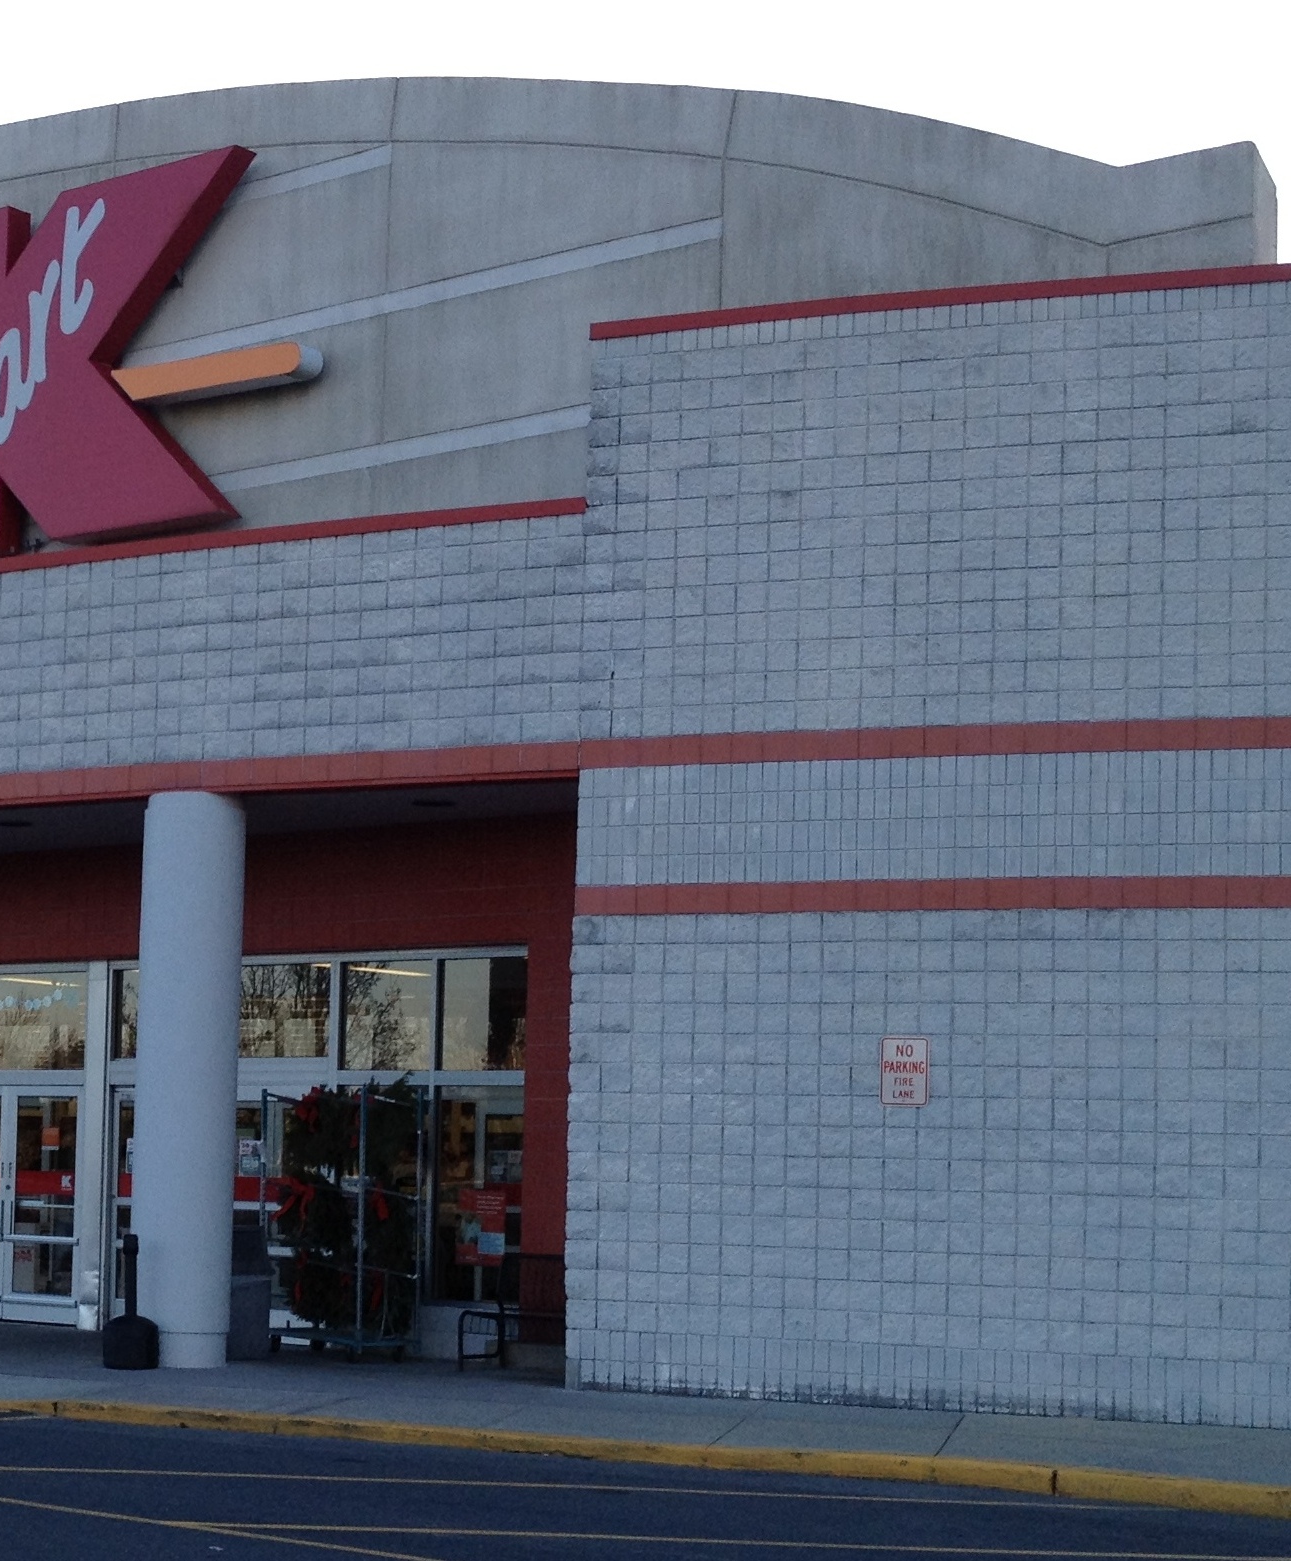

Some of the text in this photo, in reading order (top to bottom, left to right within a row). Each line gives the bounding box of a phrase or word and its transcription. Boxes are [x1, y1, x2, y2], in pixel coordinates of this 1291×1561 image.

[895, 1044, 914, 1058] NO
[883, 1061, 925, 1074] PARKING
[894, 1077, 914, 1087] FIRE
[892, 1090, 915, 1099] LANE
[61, 1175, 72, 1187] K
